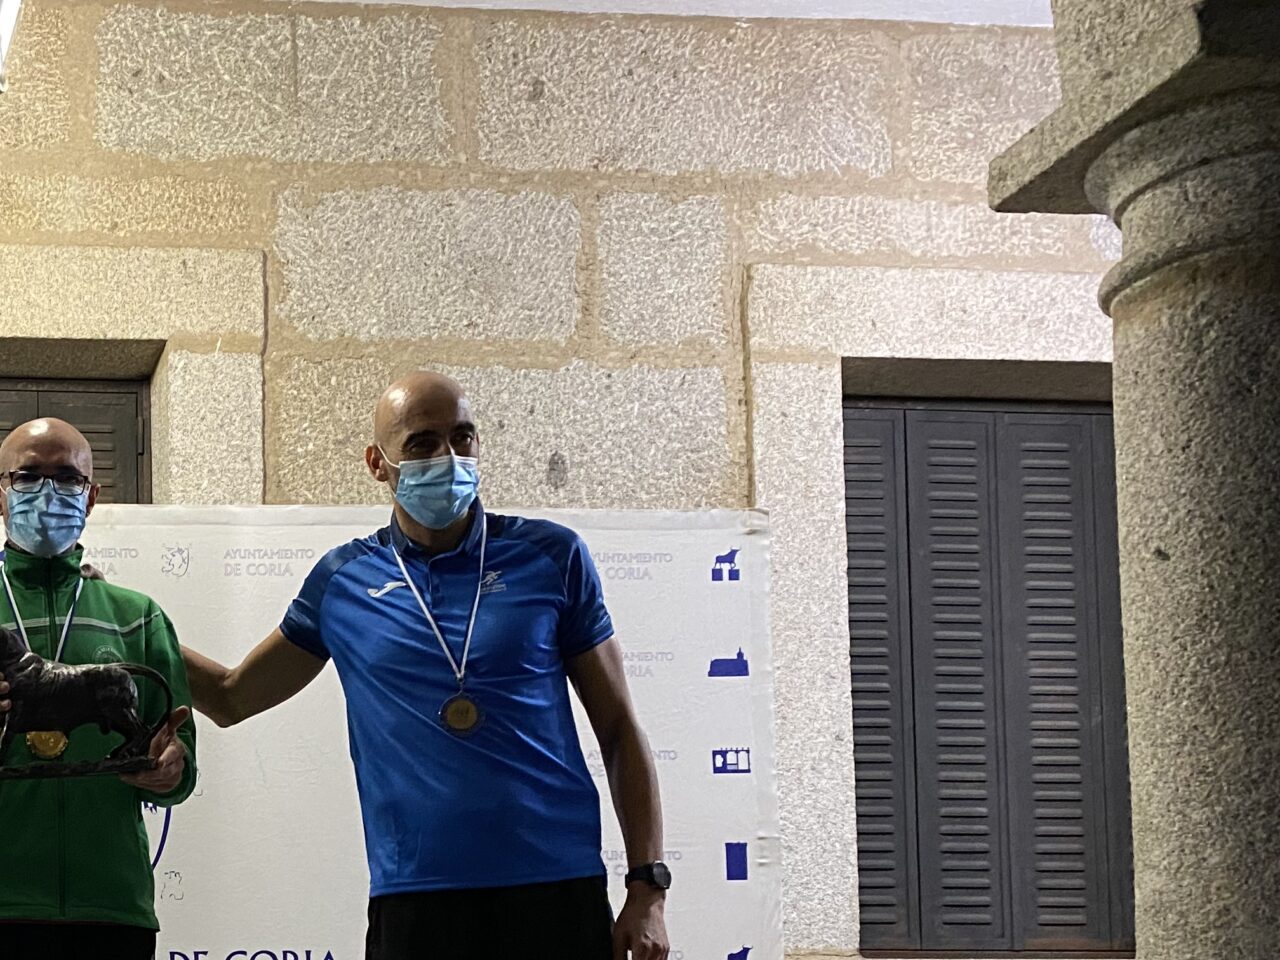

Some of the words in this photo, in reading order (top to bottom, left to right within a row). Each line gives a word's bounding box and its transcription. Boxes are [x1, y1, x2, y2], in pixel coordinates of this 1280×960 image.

[224, 548, 315, 560] AYUNTAMIENTO
[224, 563, 241, 577] DE
[245, 563, 294, 577] CORIA
[605, 567, 653, 580] CORIA
